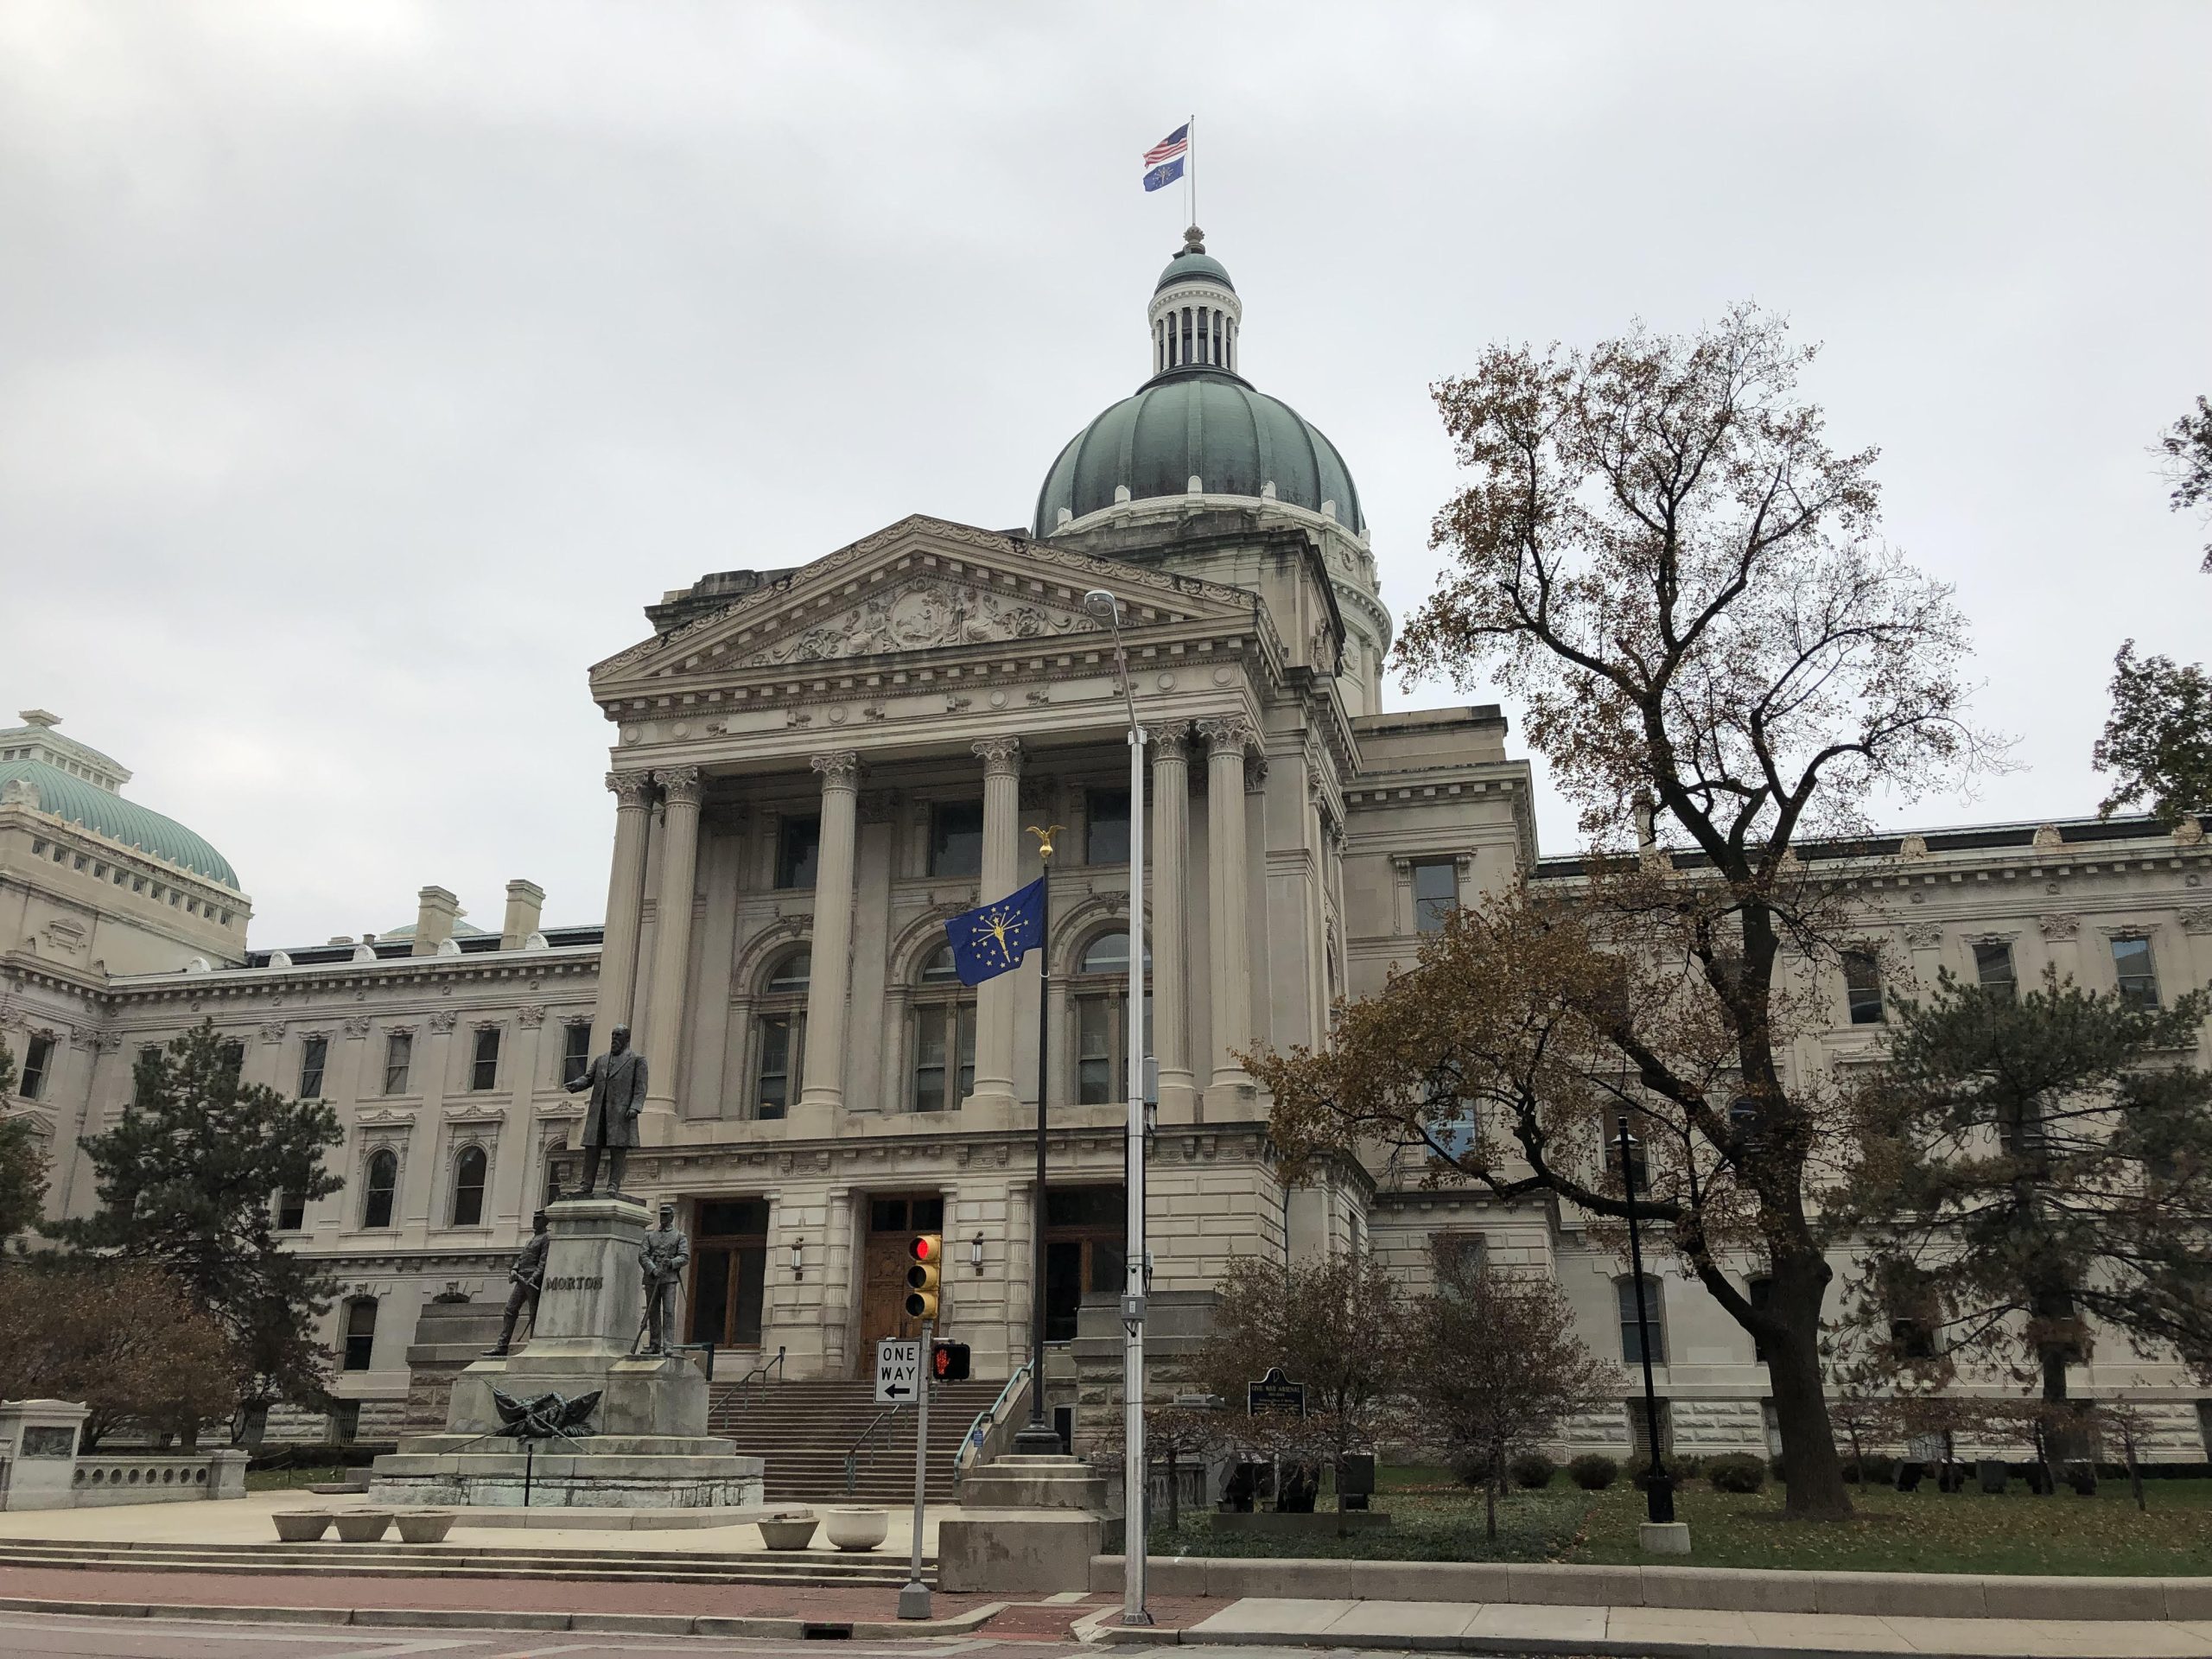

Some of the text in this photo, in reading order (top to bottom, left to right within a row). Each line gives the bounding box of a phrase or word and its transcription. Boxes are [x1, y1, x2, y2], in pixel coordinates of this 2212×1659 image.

[545, 1276, 603, 1290] MORTON
[883, 1347, 914, 1361] ONE
[881, 1366, 916, 1380] WAY
